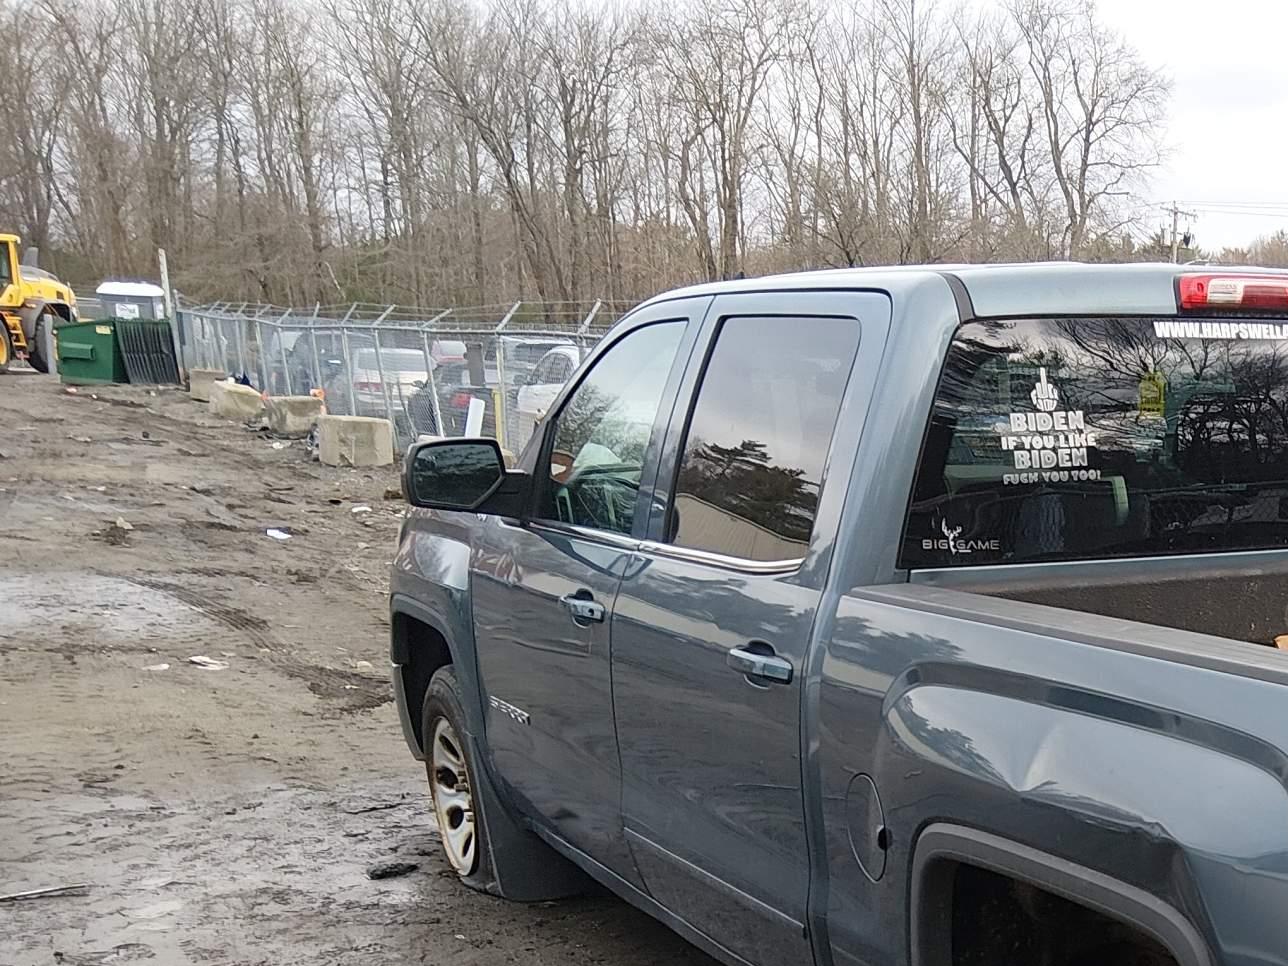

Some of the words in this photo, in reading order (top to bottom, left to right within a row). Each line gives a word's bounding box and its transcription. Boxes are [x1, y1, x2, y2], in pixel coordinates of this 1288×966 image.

[1009, 410, 1084, 432] BIDEN
[1001, 436, 1017, 450] IF
[1021, 435, 1055, 450] YOU
[1059, 433, 1097, 448] LIKE
[1013, 447, 1088, 469] BIDEN
[1003, 472, 1039, 485] FUCK
[1042, 470, 1069, 482] YOU
[1071, 469, 1101, 481] TOO!
[922, 539, 949, 550] BIG
[956, 539, 1000, 550] GAME
